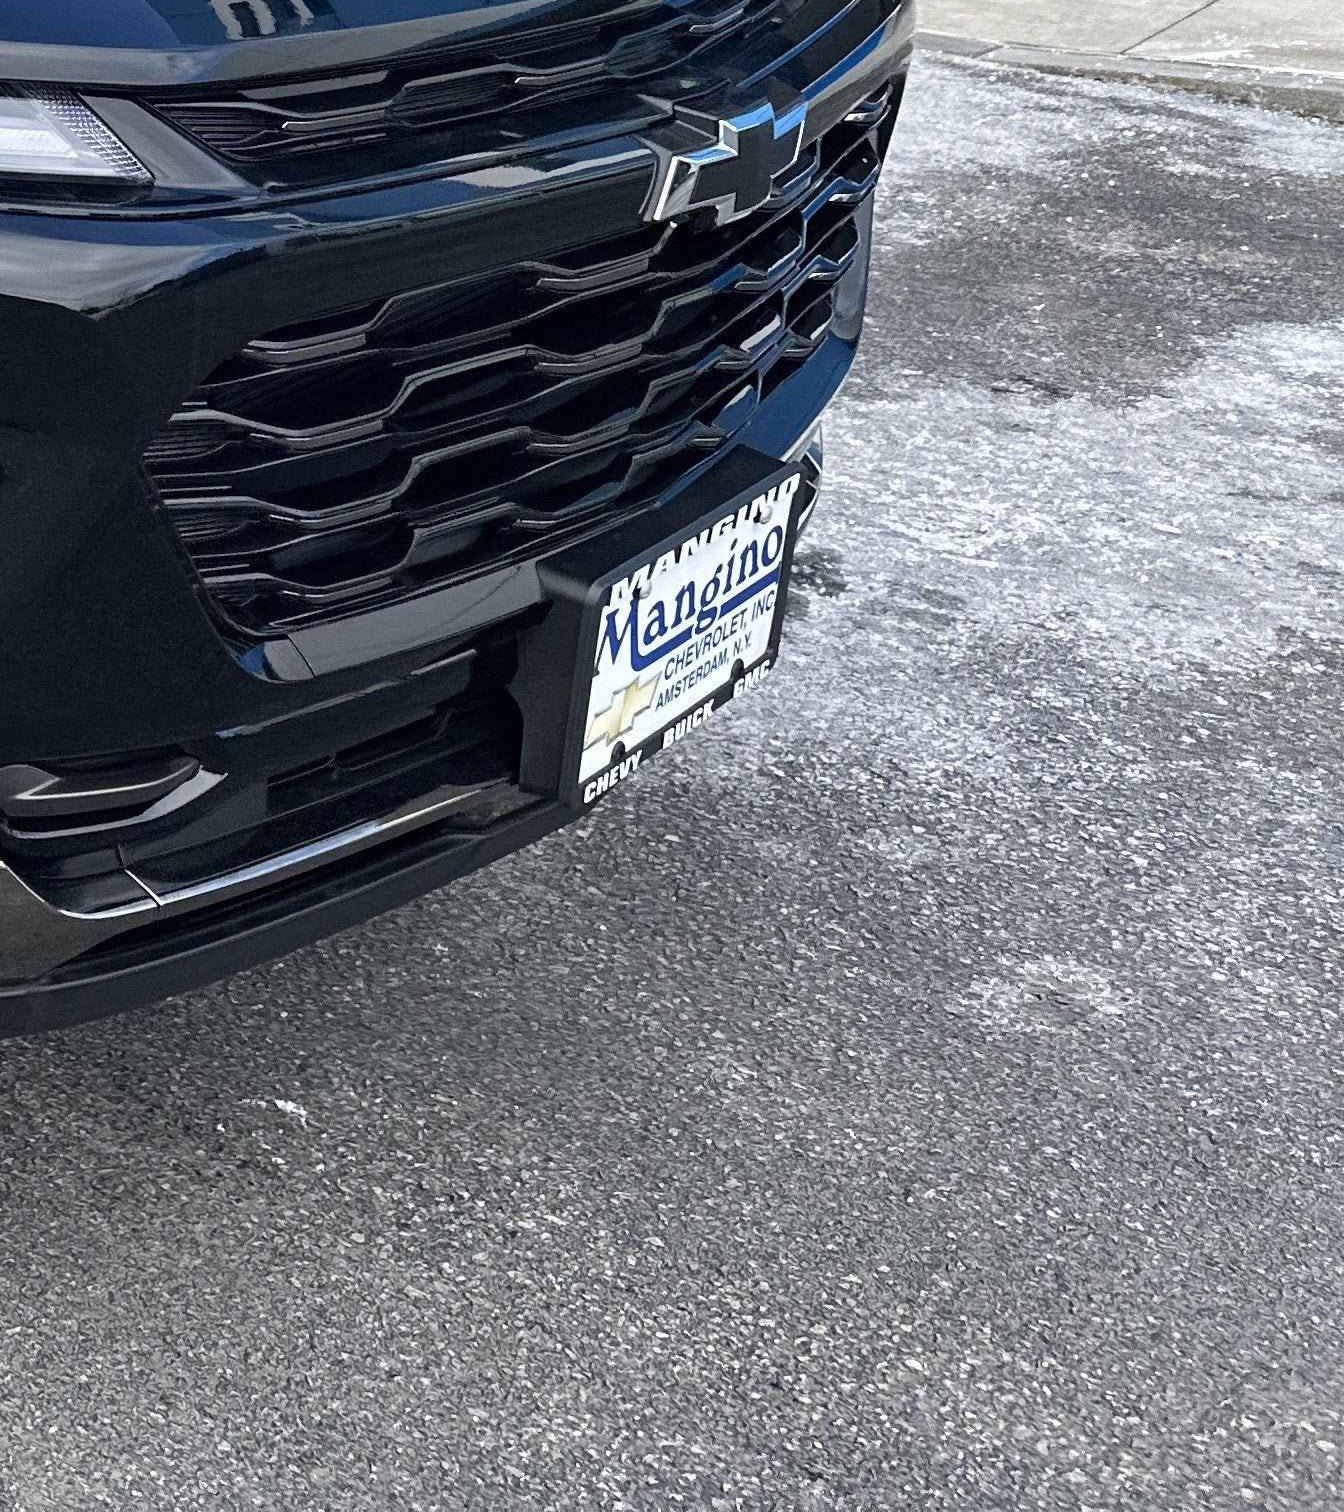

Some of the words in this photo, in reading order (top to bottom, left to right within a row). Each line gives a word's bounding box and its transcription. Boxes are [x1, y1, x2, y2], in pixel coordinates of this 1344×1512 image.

[593, 525, 783, 675] Mangino
[609, 473, 800, 607] MANGINO
[664, 608, 747, 680] CHEVROLET,
[584, 750, 642, 804] CHEVY
[663, 699, 715, 750] BUICK
[733, 662, 771, 698] GMC
